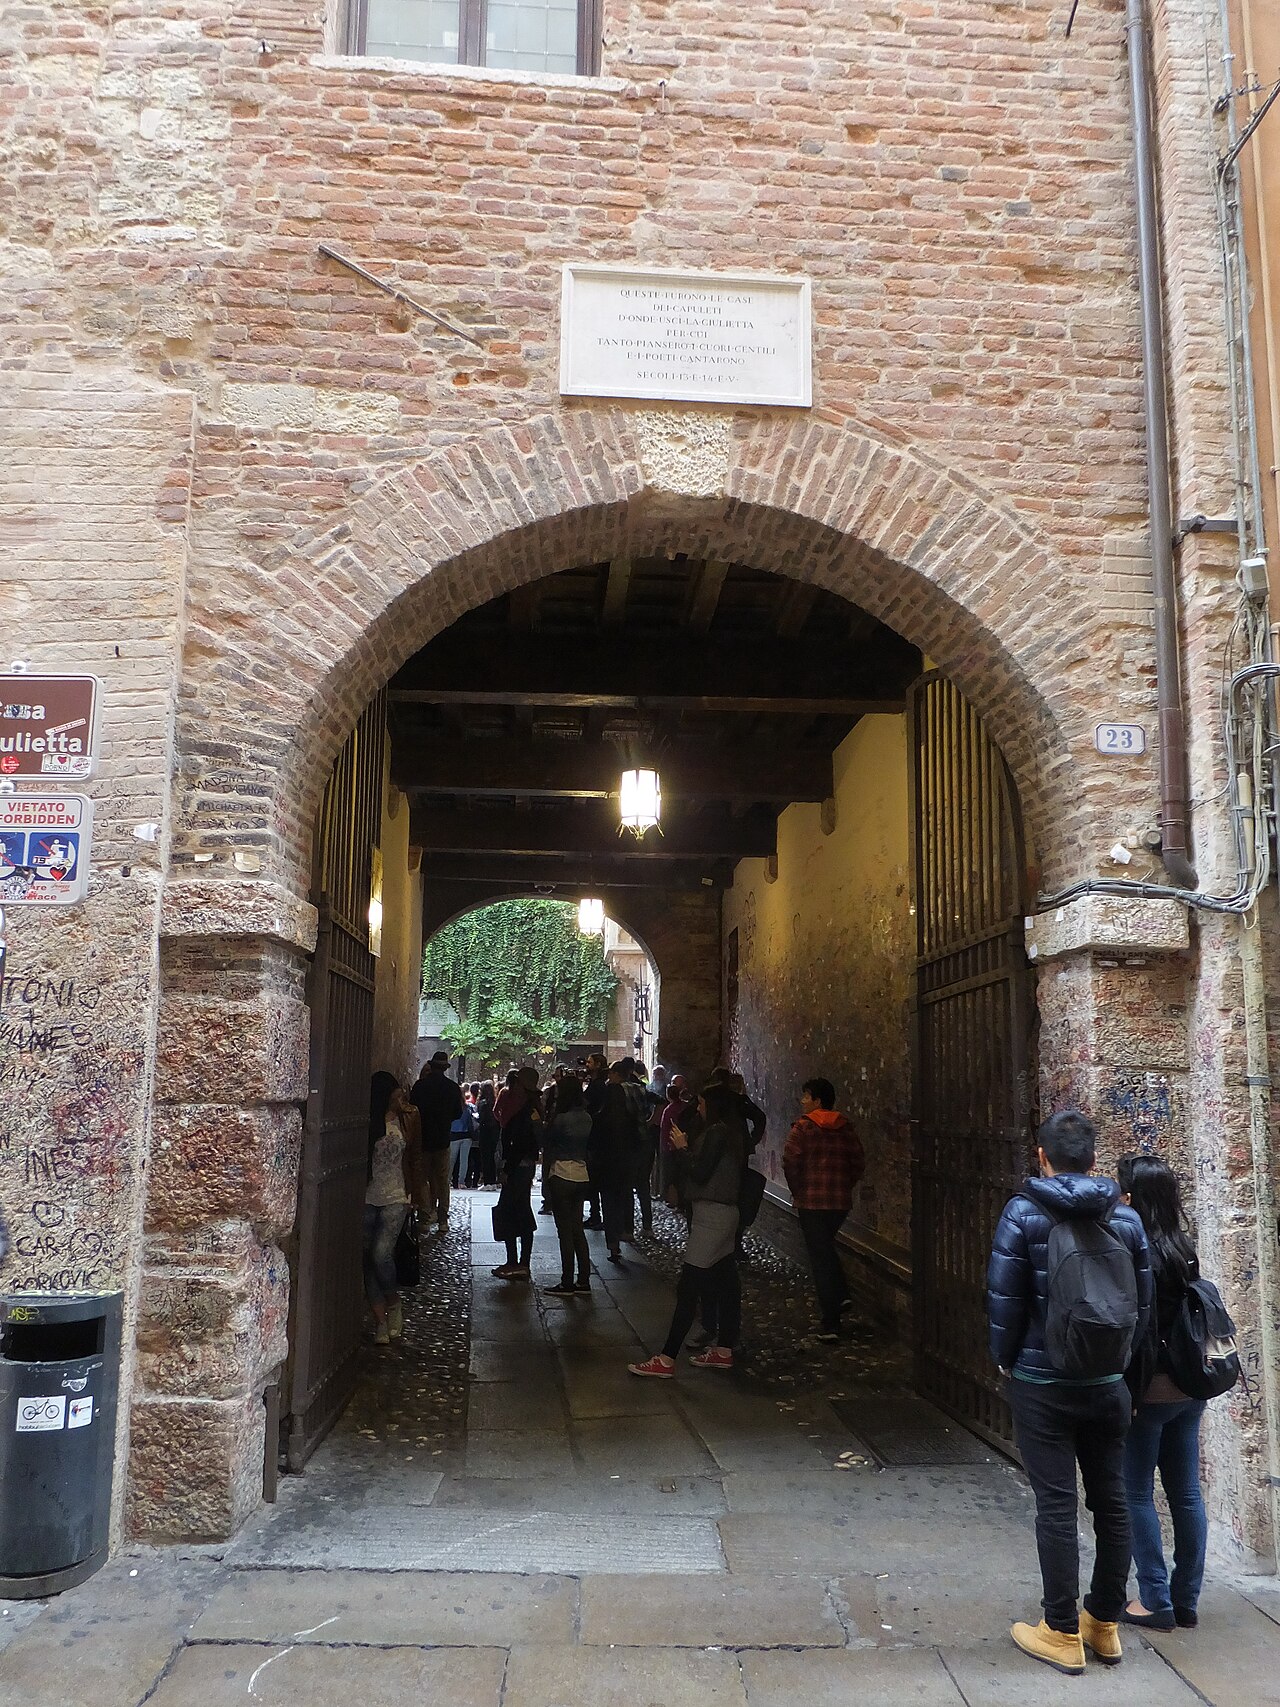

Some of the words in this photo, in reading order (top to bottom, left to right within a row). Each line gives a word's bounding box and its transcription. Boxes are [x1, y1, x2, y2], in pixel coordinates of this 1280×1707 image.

[673, 304, 722, 314] CAPULETI
[702, 319, 754, 328] GIULIETTA
[597, 338, 633, 346] TANTO
[636, 340, 688, 349] PIANSERO
[700, 344, 731, 352] CUORI
[734, 346, 776, 354] GENTILI
[646, 353, 676, 361] POETI
[680, 355, 745, 364] CANTARONO
[636, 372, 675, 380] SECOLI
[1106, 730, 1133, 748] 23
[8, 802, 66, 812] VIETATO
